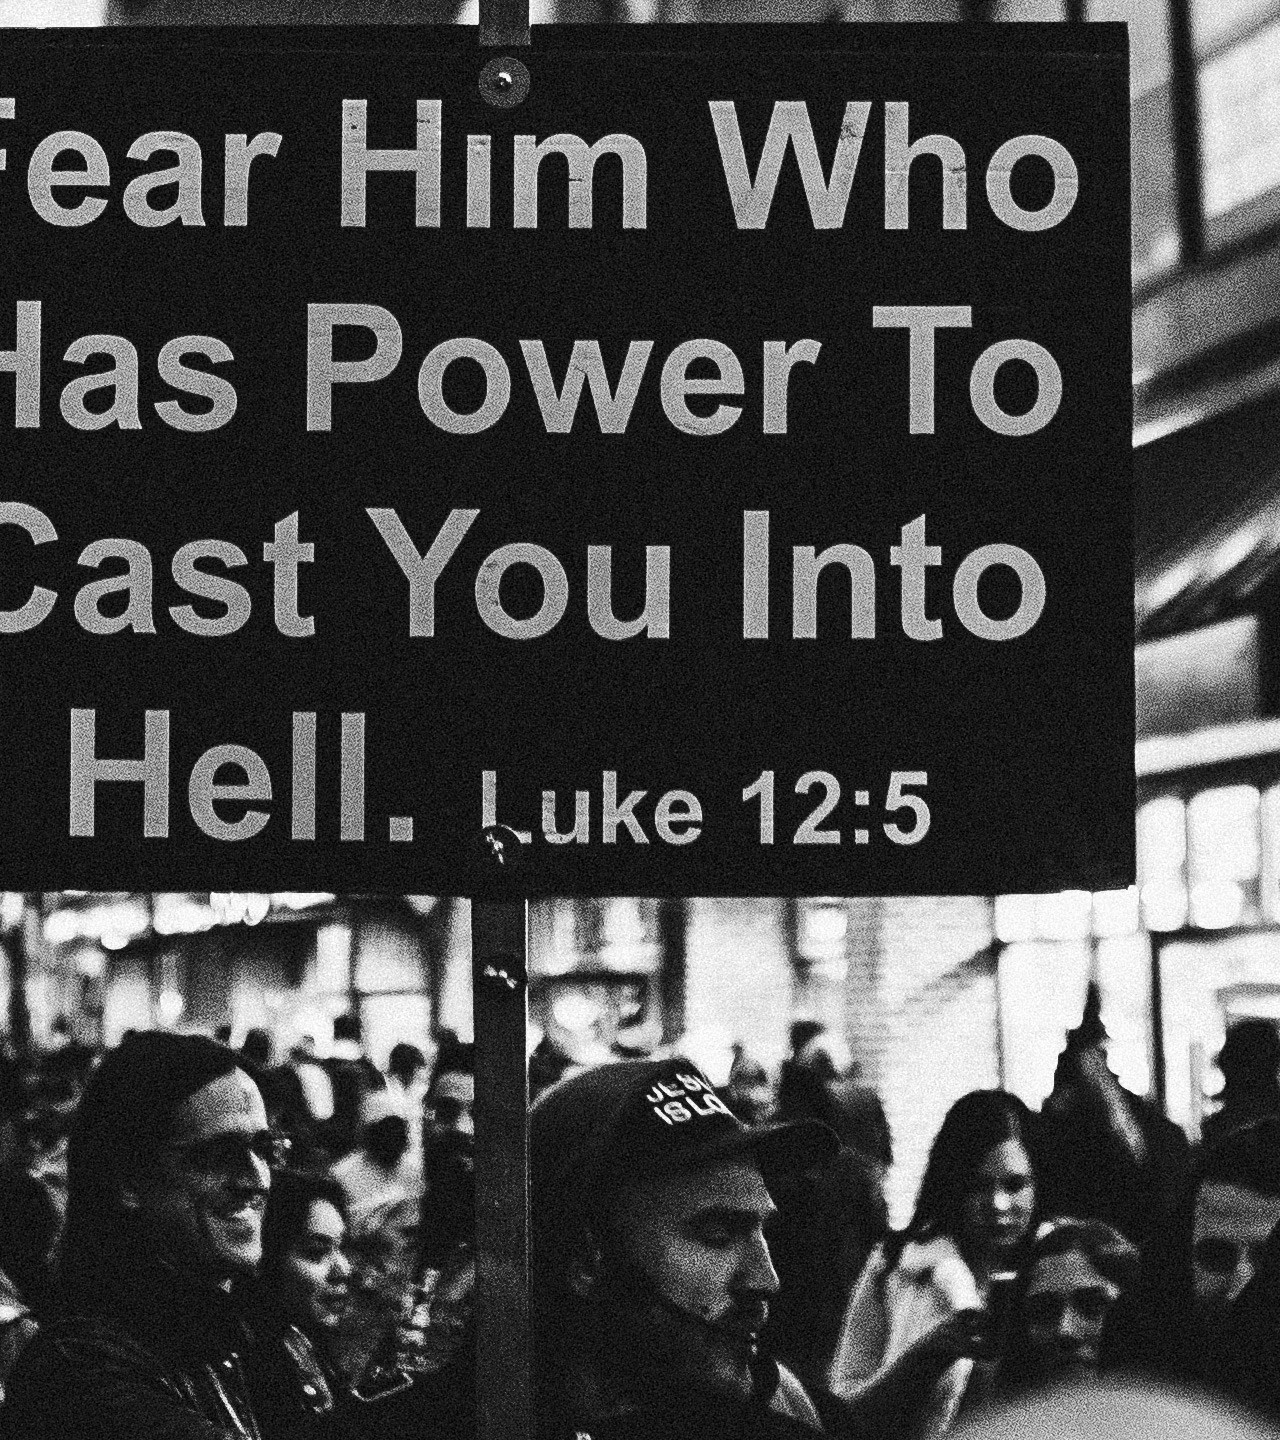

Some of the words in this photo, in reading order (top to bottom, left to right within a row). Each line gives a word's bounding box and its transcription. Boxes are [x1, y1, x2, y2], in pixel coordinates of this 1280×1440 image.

[341, 98, 647, 229] Him
[708, 100, 1079, 232] Who
[306, 303, 822, 436] Power
[872, 305, 1063, 436] To
[366, 507, 671, 641] You
[743, 510, 1046, 641] Into
[69, 708, 414, 842] Hell.
[481, 770, 703, 845] Luke
[742, 770, 931, 845] 12:5
